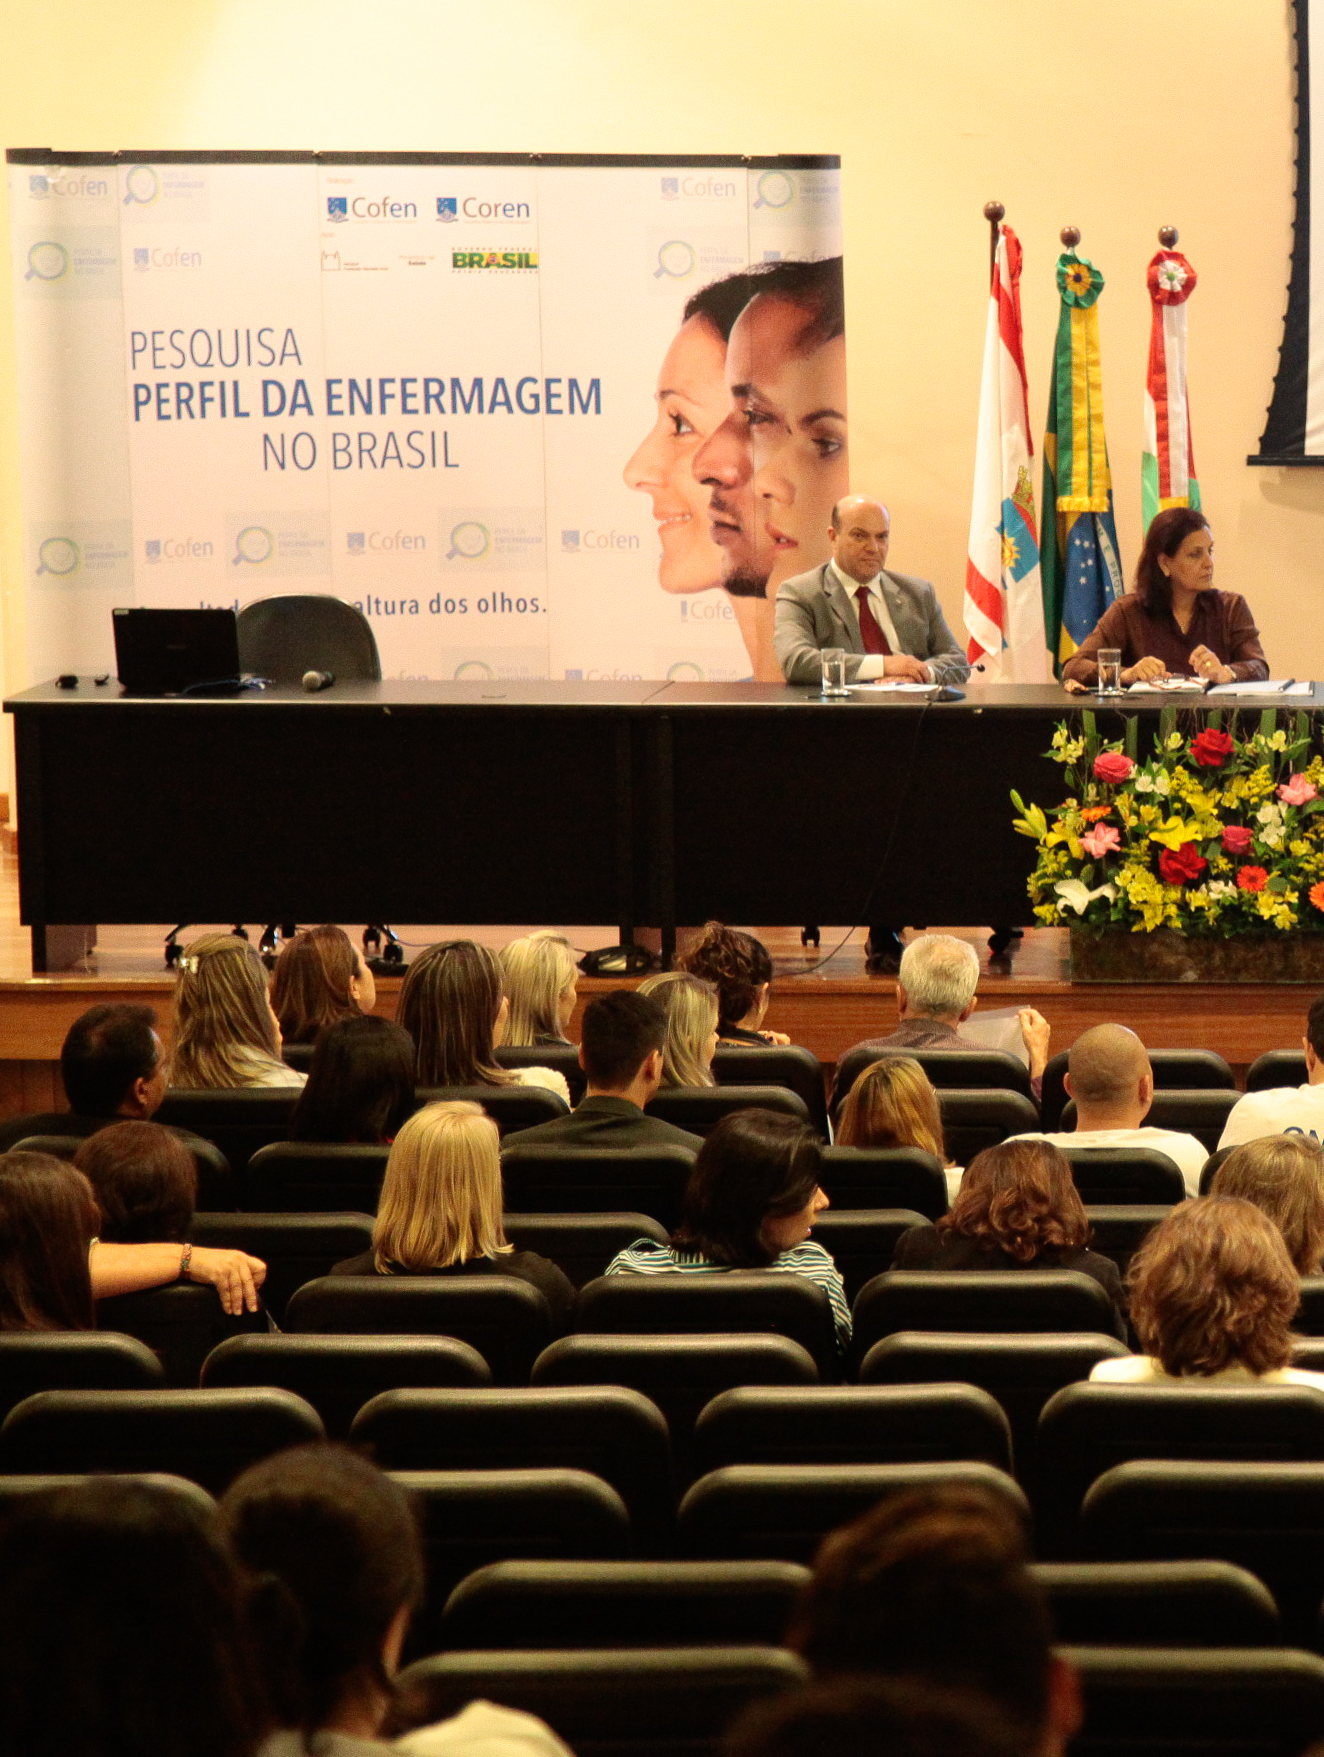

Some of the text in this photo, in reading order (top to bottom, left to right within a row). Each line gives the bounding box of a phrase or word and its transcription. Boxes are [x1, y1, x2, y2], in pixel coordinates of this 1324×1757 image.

[52, 174, 108, 197] Cofen
[682, 175, 736, 198] Cofen
[351, 196, 418, 219] Cofen
[462, 196, 530, 219] Coren
[151, 246, 202, 268] Cofen
[451, 251, 539, 269] BRASIL
[130, 327, 303, 371] PESQUISA
[134, 376, 601, 422] PERFIL DA ENFERMAGEM
[263, 429, 460, 471] NO BRASIL
[163, 537, 214, 559] Cofen
[368, 530, 427, 551] Cofen
[583, 529, 641, 550] Cofen
[353, 591, 547, 616] altura dos olhos.
[690, 600, 737, 620] Cofe
